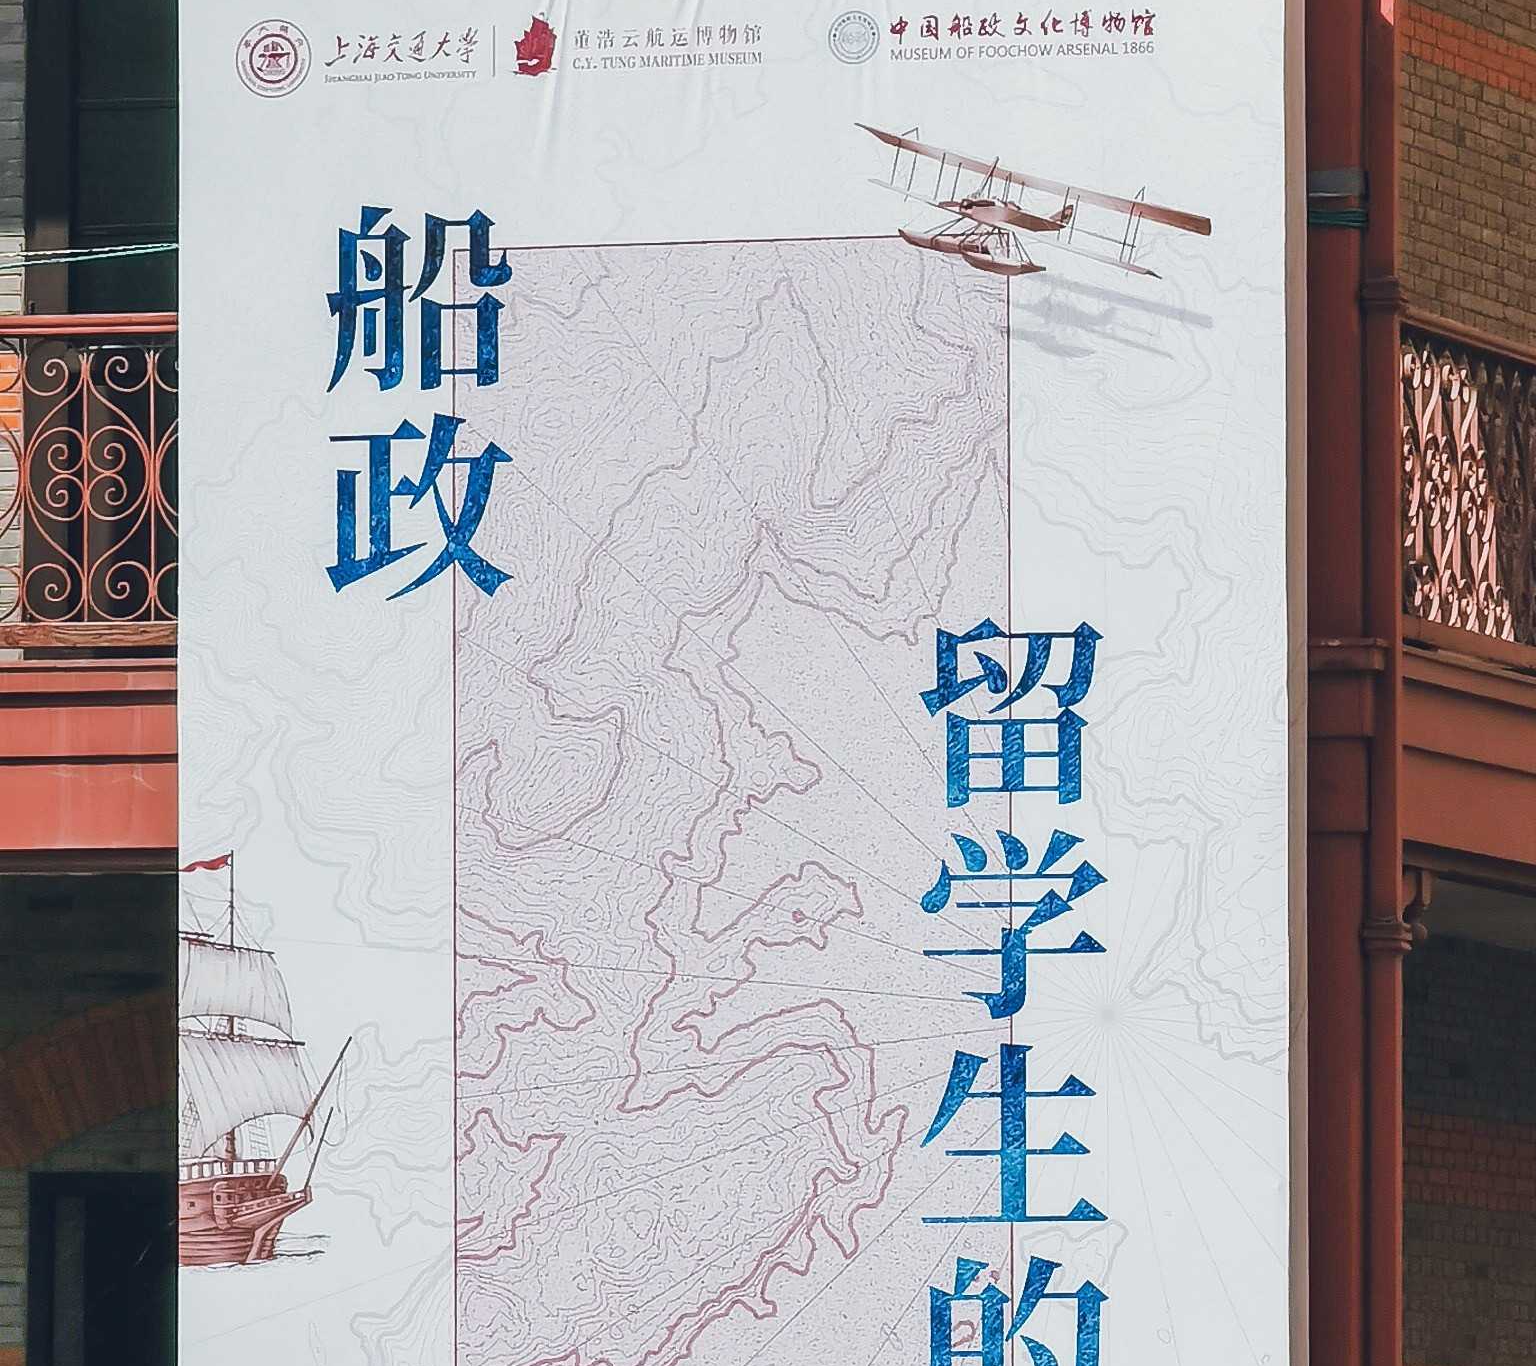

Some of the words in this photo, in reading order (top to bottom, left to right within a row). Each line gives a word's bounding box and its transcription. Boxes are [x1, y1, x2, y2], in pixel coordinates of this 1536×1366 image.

[574, 24, 762, 50] 董浩云航运博物馆
[889, 9, 1157, 45] 中国船政文化博物馆
[573, 58, 597, 70] C.Y.
[601, 56, 636, 69] TUNG
[639, 54, 705, 68] MARITIME
[708, 51, 762, 66] MUSEUM
[890, 44, 951, 61] MUSEUM
[956, 44, 975, 60] OF
[979, 42, 1053, 59] FOOCHOW
[1056, 41, 1118, 56] ARSENAL
[1122, 41, 1155, 55] 1866
[326, 205, 515, 602] 船政
